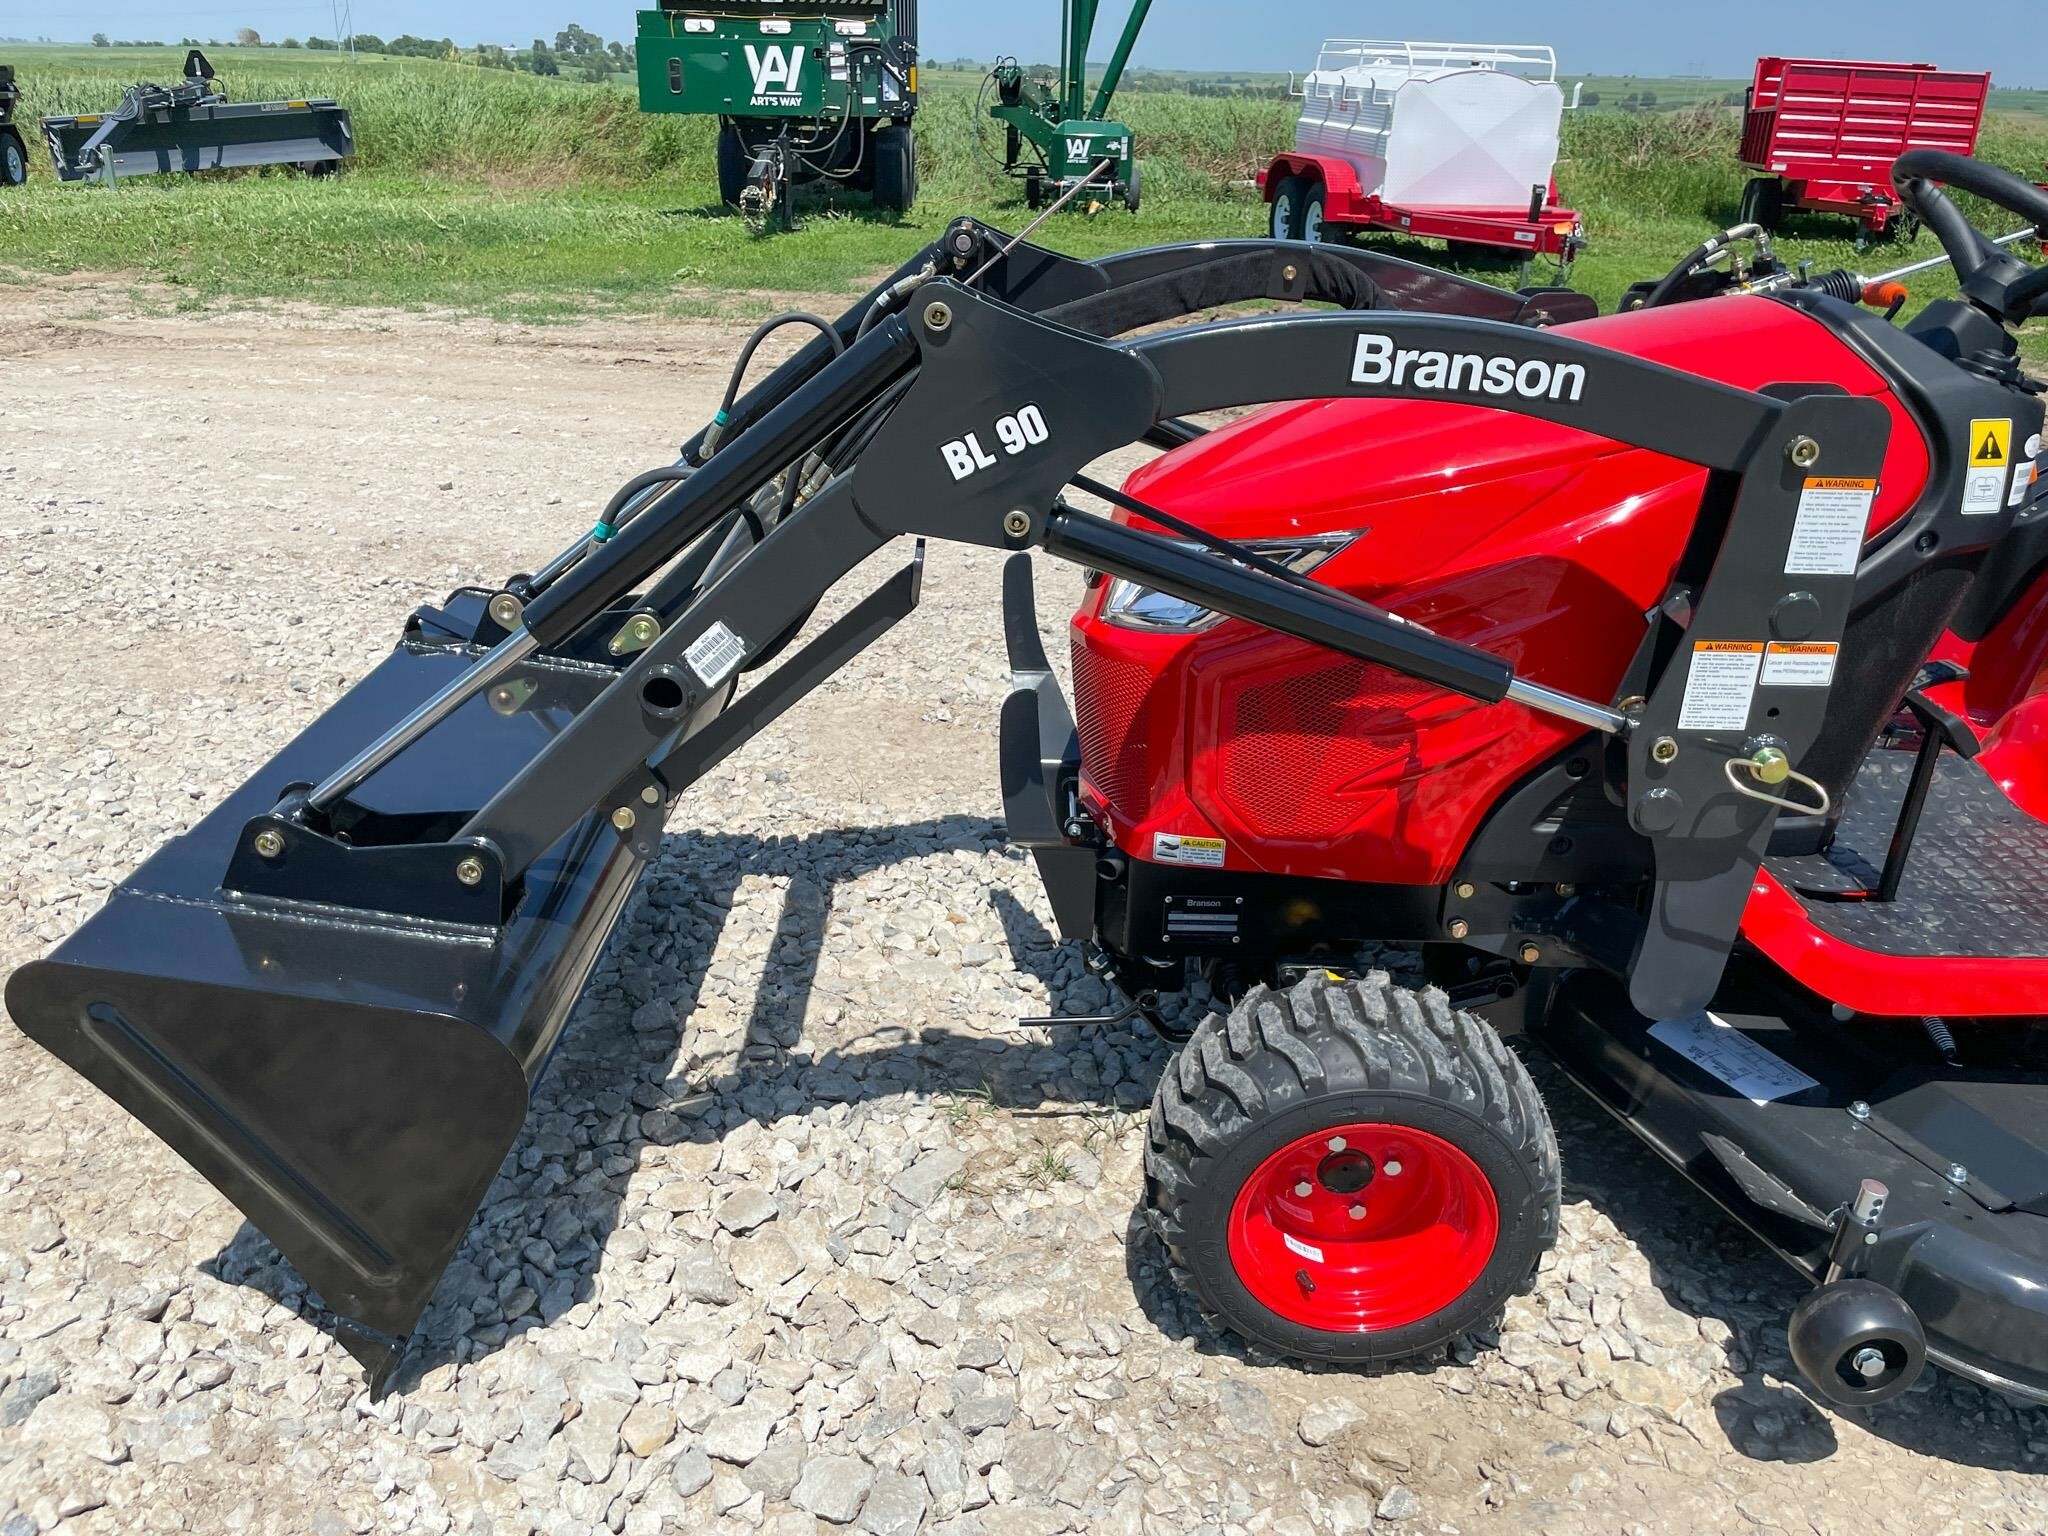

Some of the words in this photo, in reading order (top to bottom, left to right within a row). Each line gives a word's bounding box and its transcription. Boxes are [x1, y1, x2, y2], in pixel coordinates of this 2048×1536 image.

[750, 95, 778, 106] ART'S
[780, 96, 803, 107] WAY
[1351, 333, 1586, 402] Branson
[940, 431, 997, 481] BL
[995, 404, 1049, 455] 90
[1825, 479, 1865, 488] WARNING
[1715, 643, 1753, 651] WARNING
[1789, 645, 1827, 653] WARNING
[1186, 899, 1221, 907] Branson
